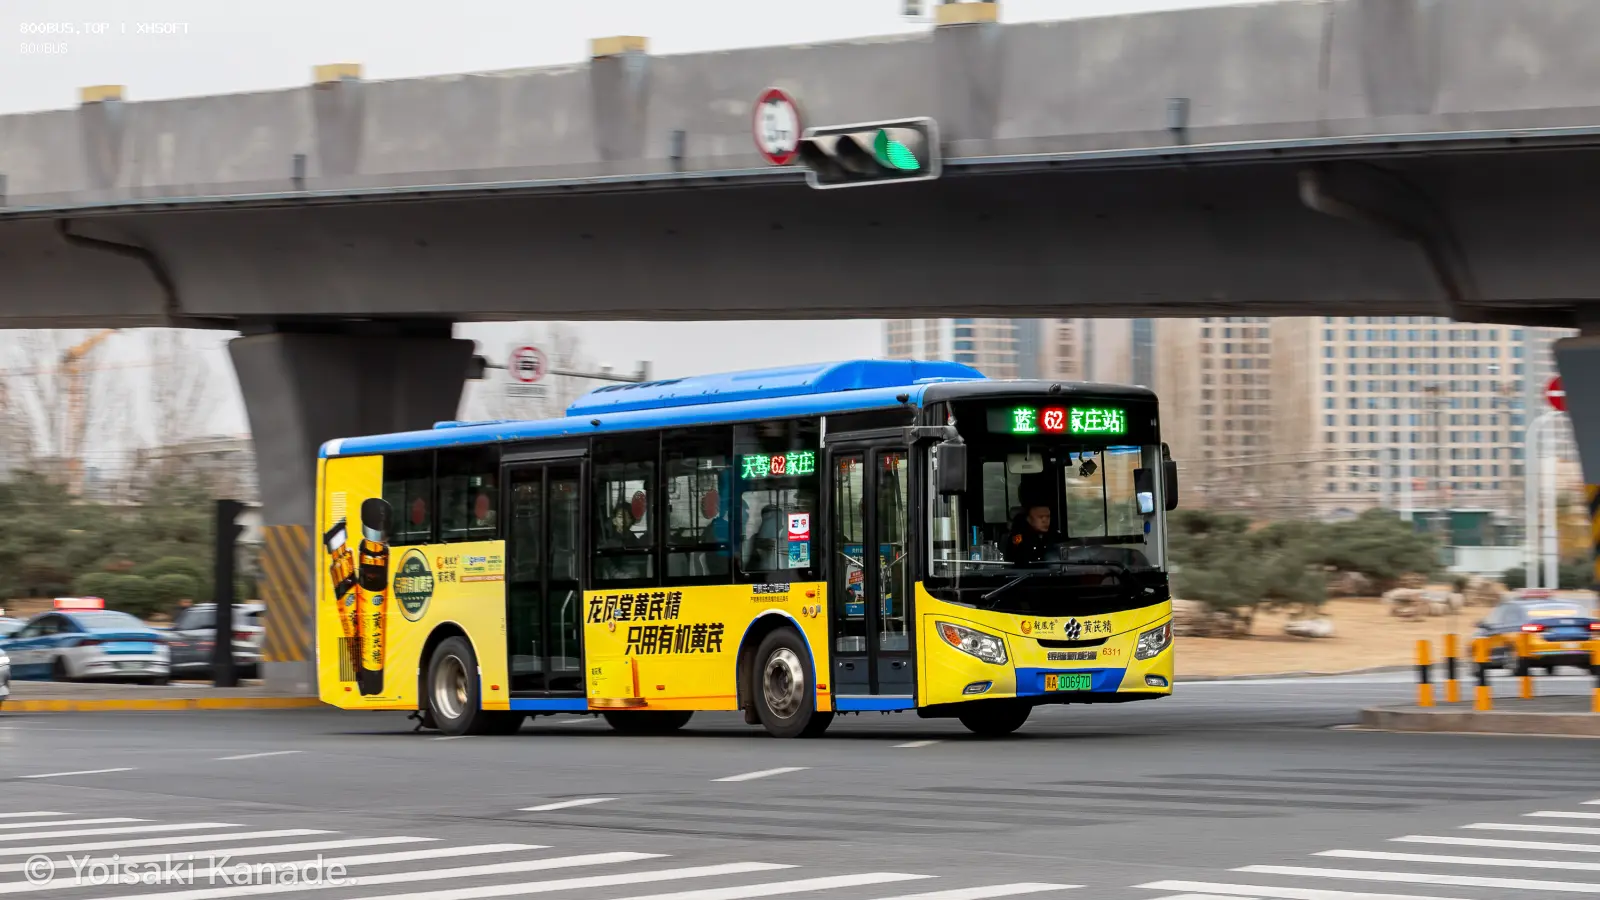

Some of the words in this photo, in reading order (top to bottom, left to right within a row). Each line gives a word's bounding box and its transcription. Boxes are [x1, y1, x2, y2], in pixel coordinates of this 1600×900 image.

[1013, 408, 1036, 433] 蓝
[1044, 410, 1064, 429] 62
[741, 454, 770, 479] 天驾
[771, 455, 786, 474] 62
[587, 591, 682, 624] 龙凤堂黄芪精
[625, 623, 724, 655] 只用有机黄芪
[1102, 648, 1121, 656] 6311
